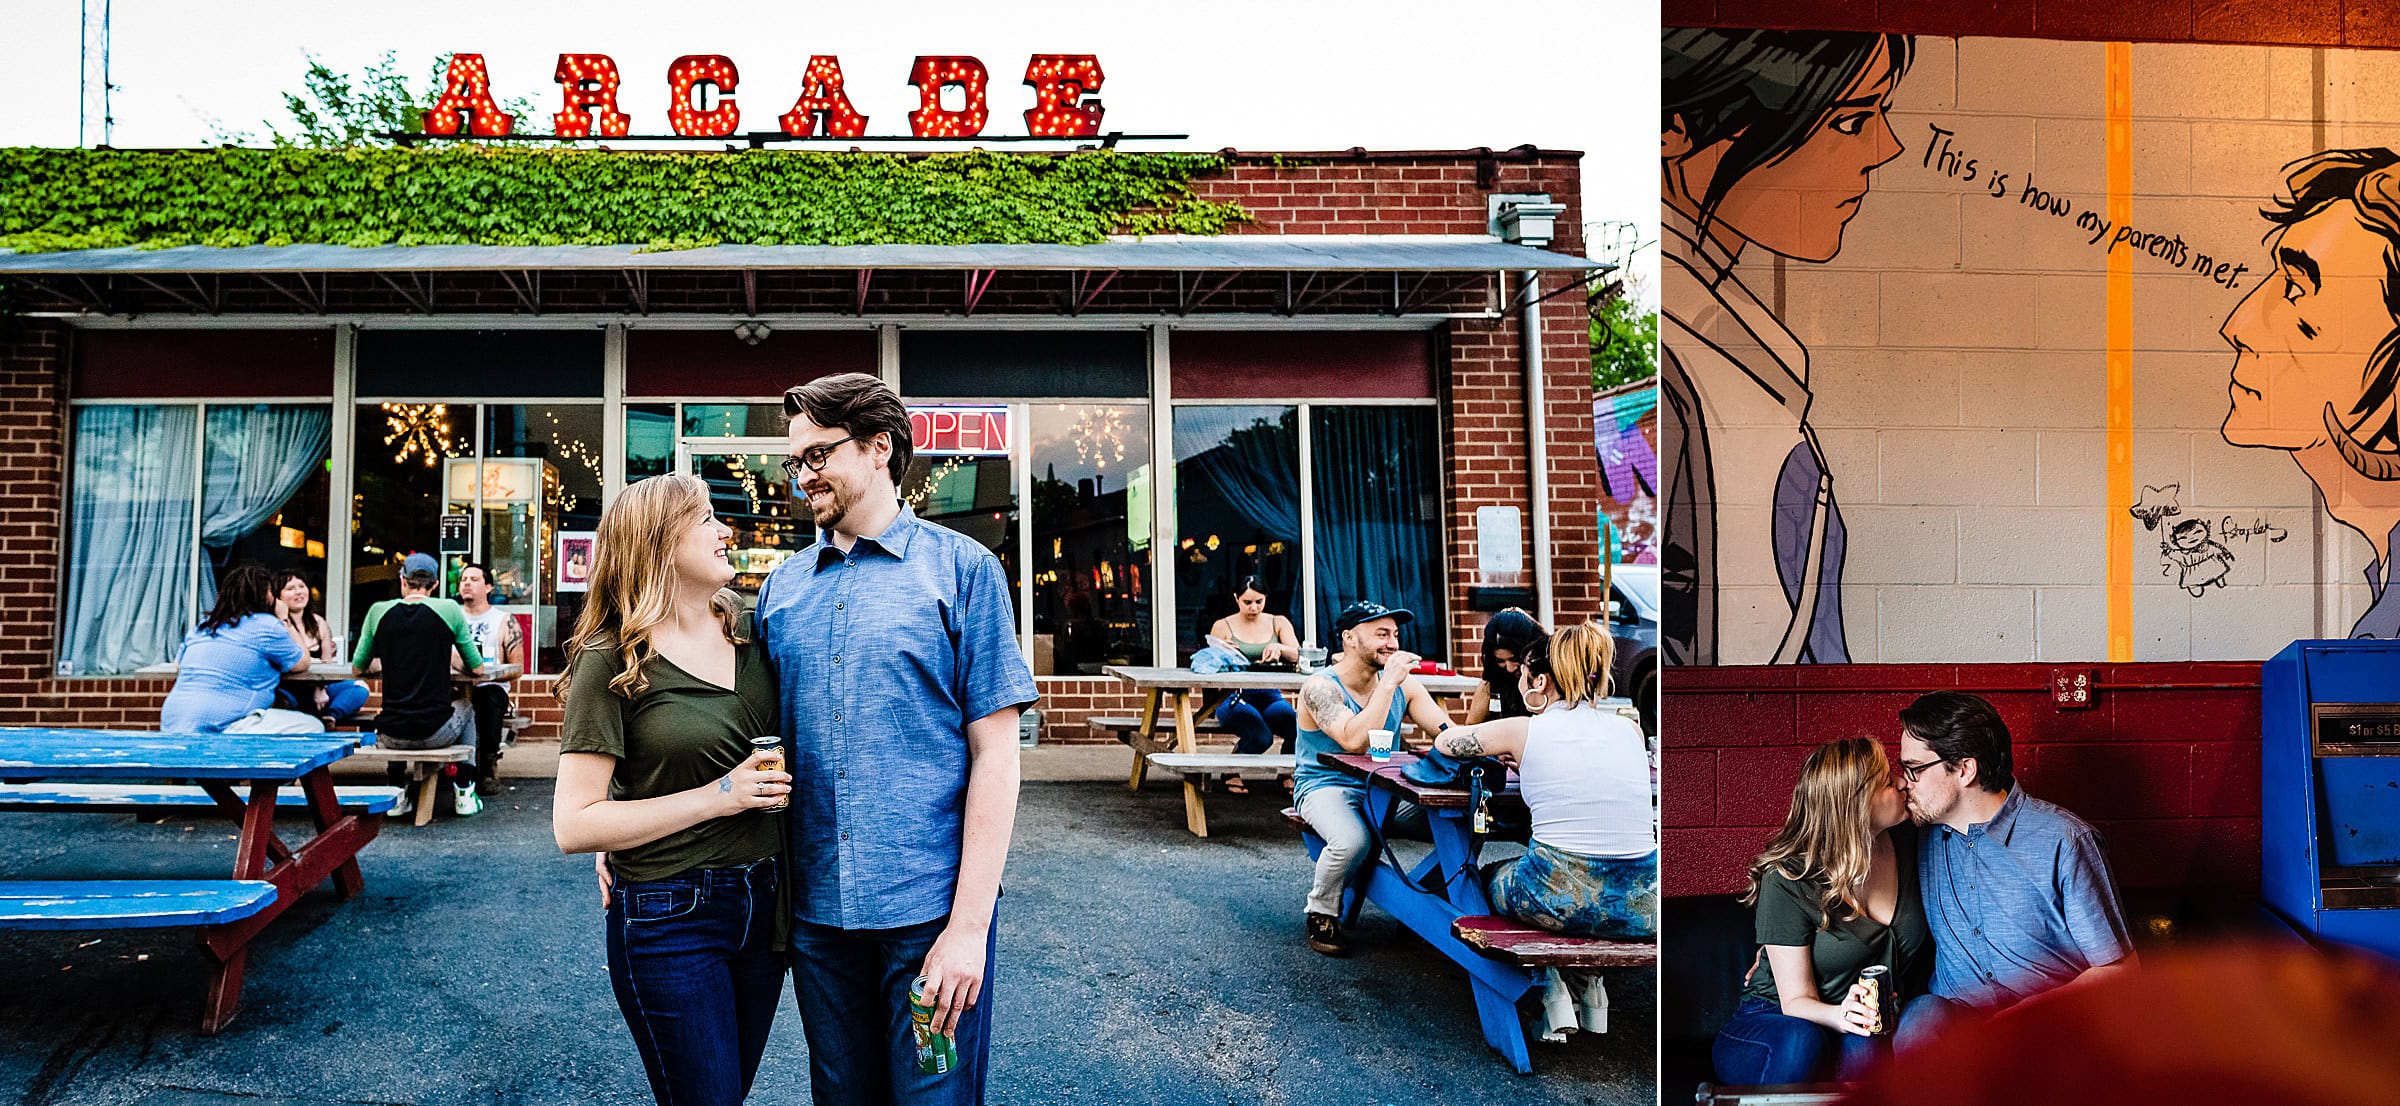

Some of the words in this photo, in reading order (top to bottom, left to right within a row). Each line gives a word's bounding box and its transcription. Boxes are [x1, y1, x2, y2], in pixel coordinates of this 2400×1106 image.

[422, 53, 1106, 137] ARCADE
[1923, 122, 1978, 181] This
[1988, 170, 2008, 198] is
[2020, 173, 2071, 218] how
[2076, 211, 2112, 245] my
[2107, 225, 2189, 268] parents
[2192, 252, 2249, 290] met.
[910, 411, 1008, 450] OPEN
[2349, 724, 2361, 736] $1
[2363, 727, 2374, 736] or
[2376, 724, 2390, 736] $5
